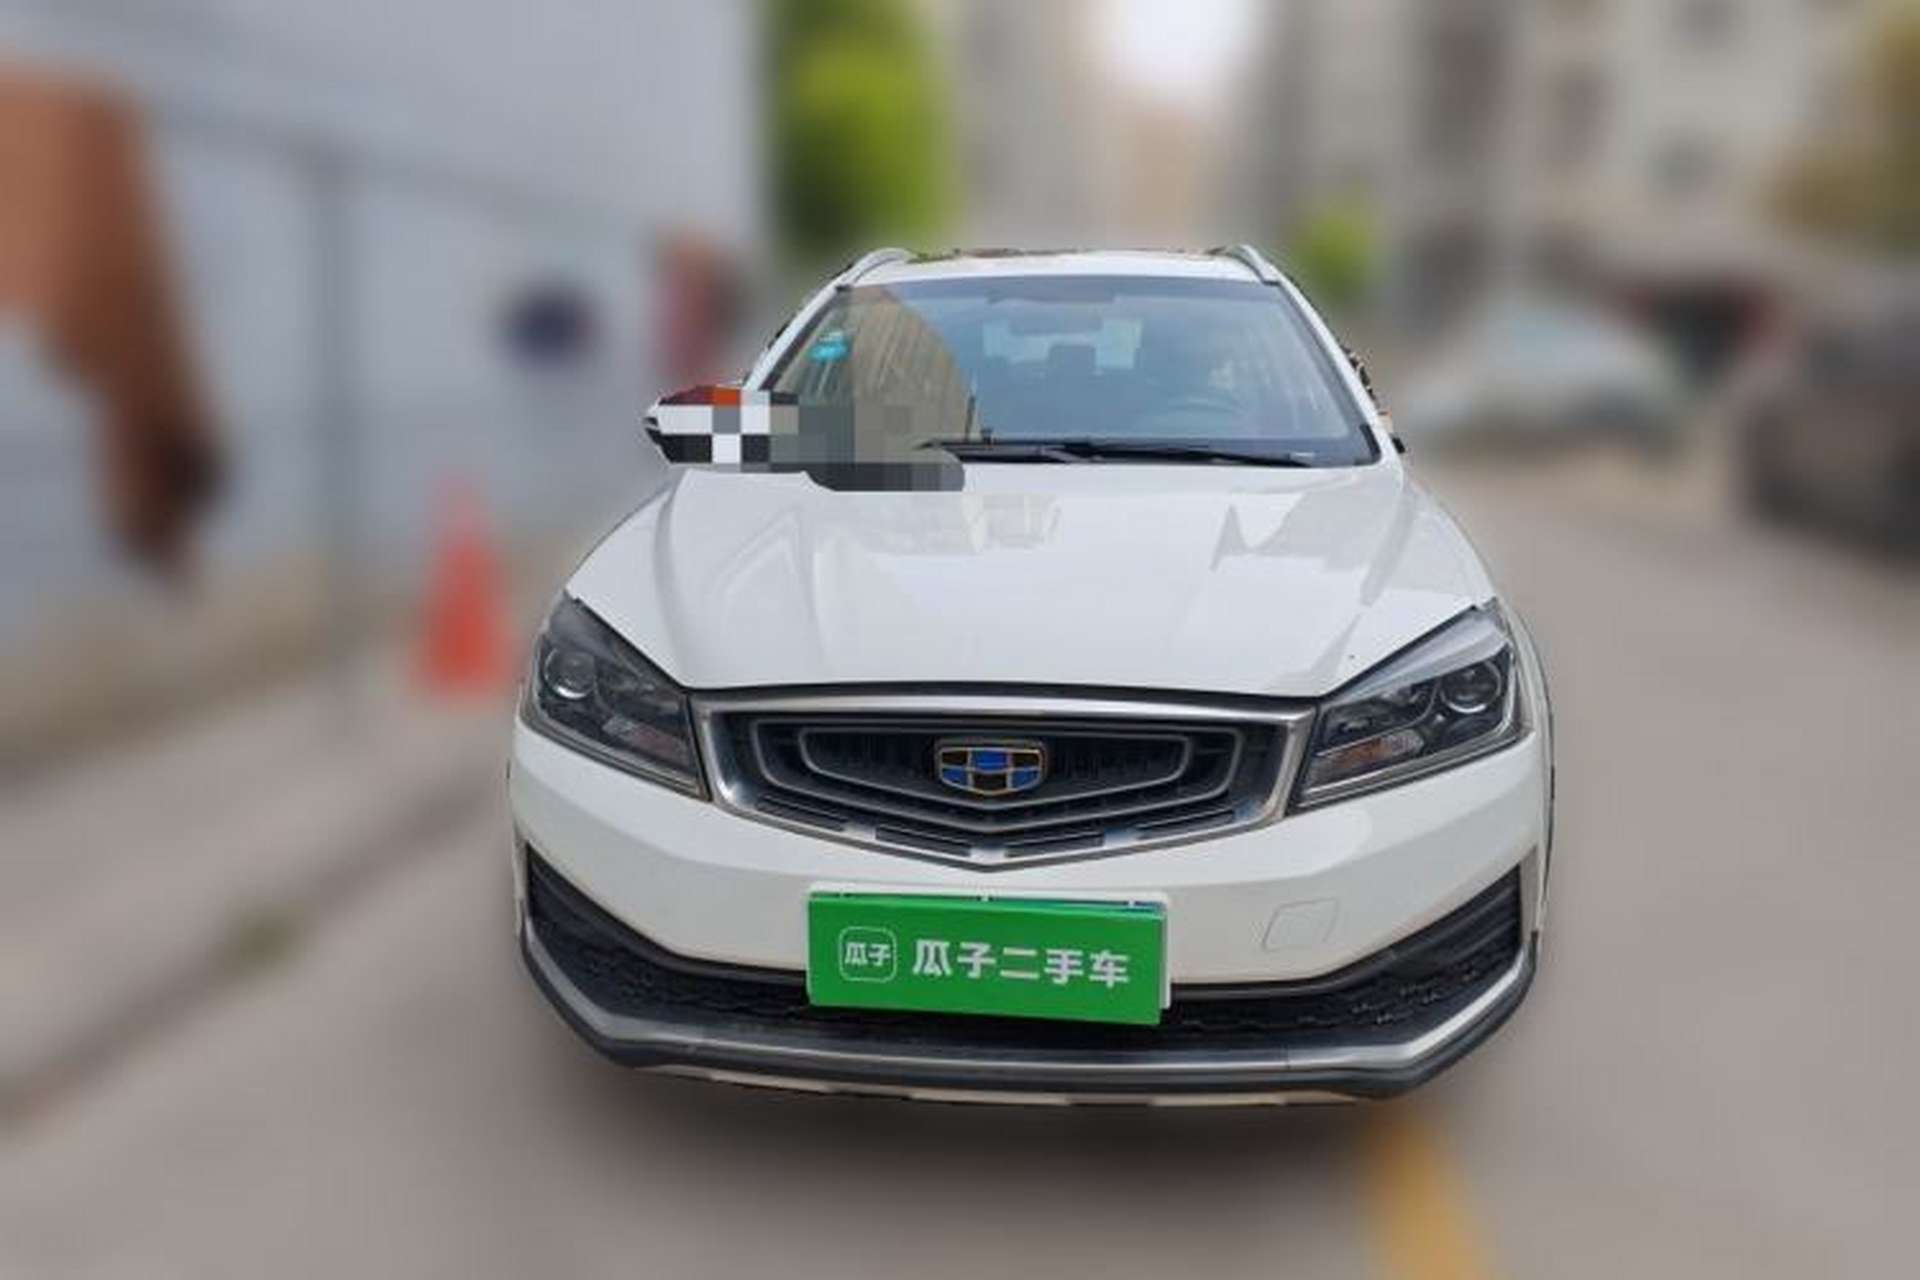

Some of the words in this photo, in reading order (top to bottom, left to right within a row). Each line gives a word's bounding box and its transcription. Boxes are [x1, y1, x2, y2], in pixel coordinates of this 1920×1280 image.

[844, 942, 892, 967] 瓜子
[912, 939, 1131, 988] 瓜子二手车
